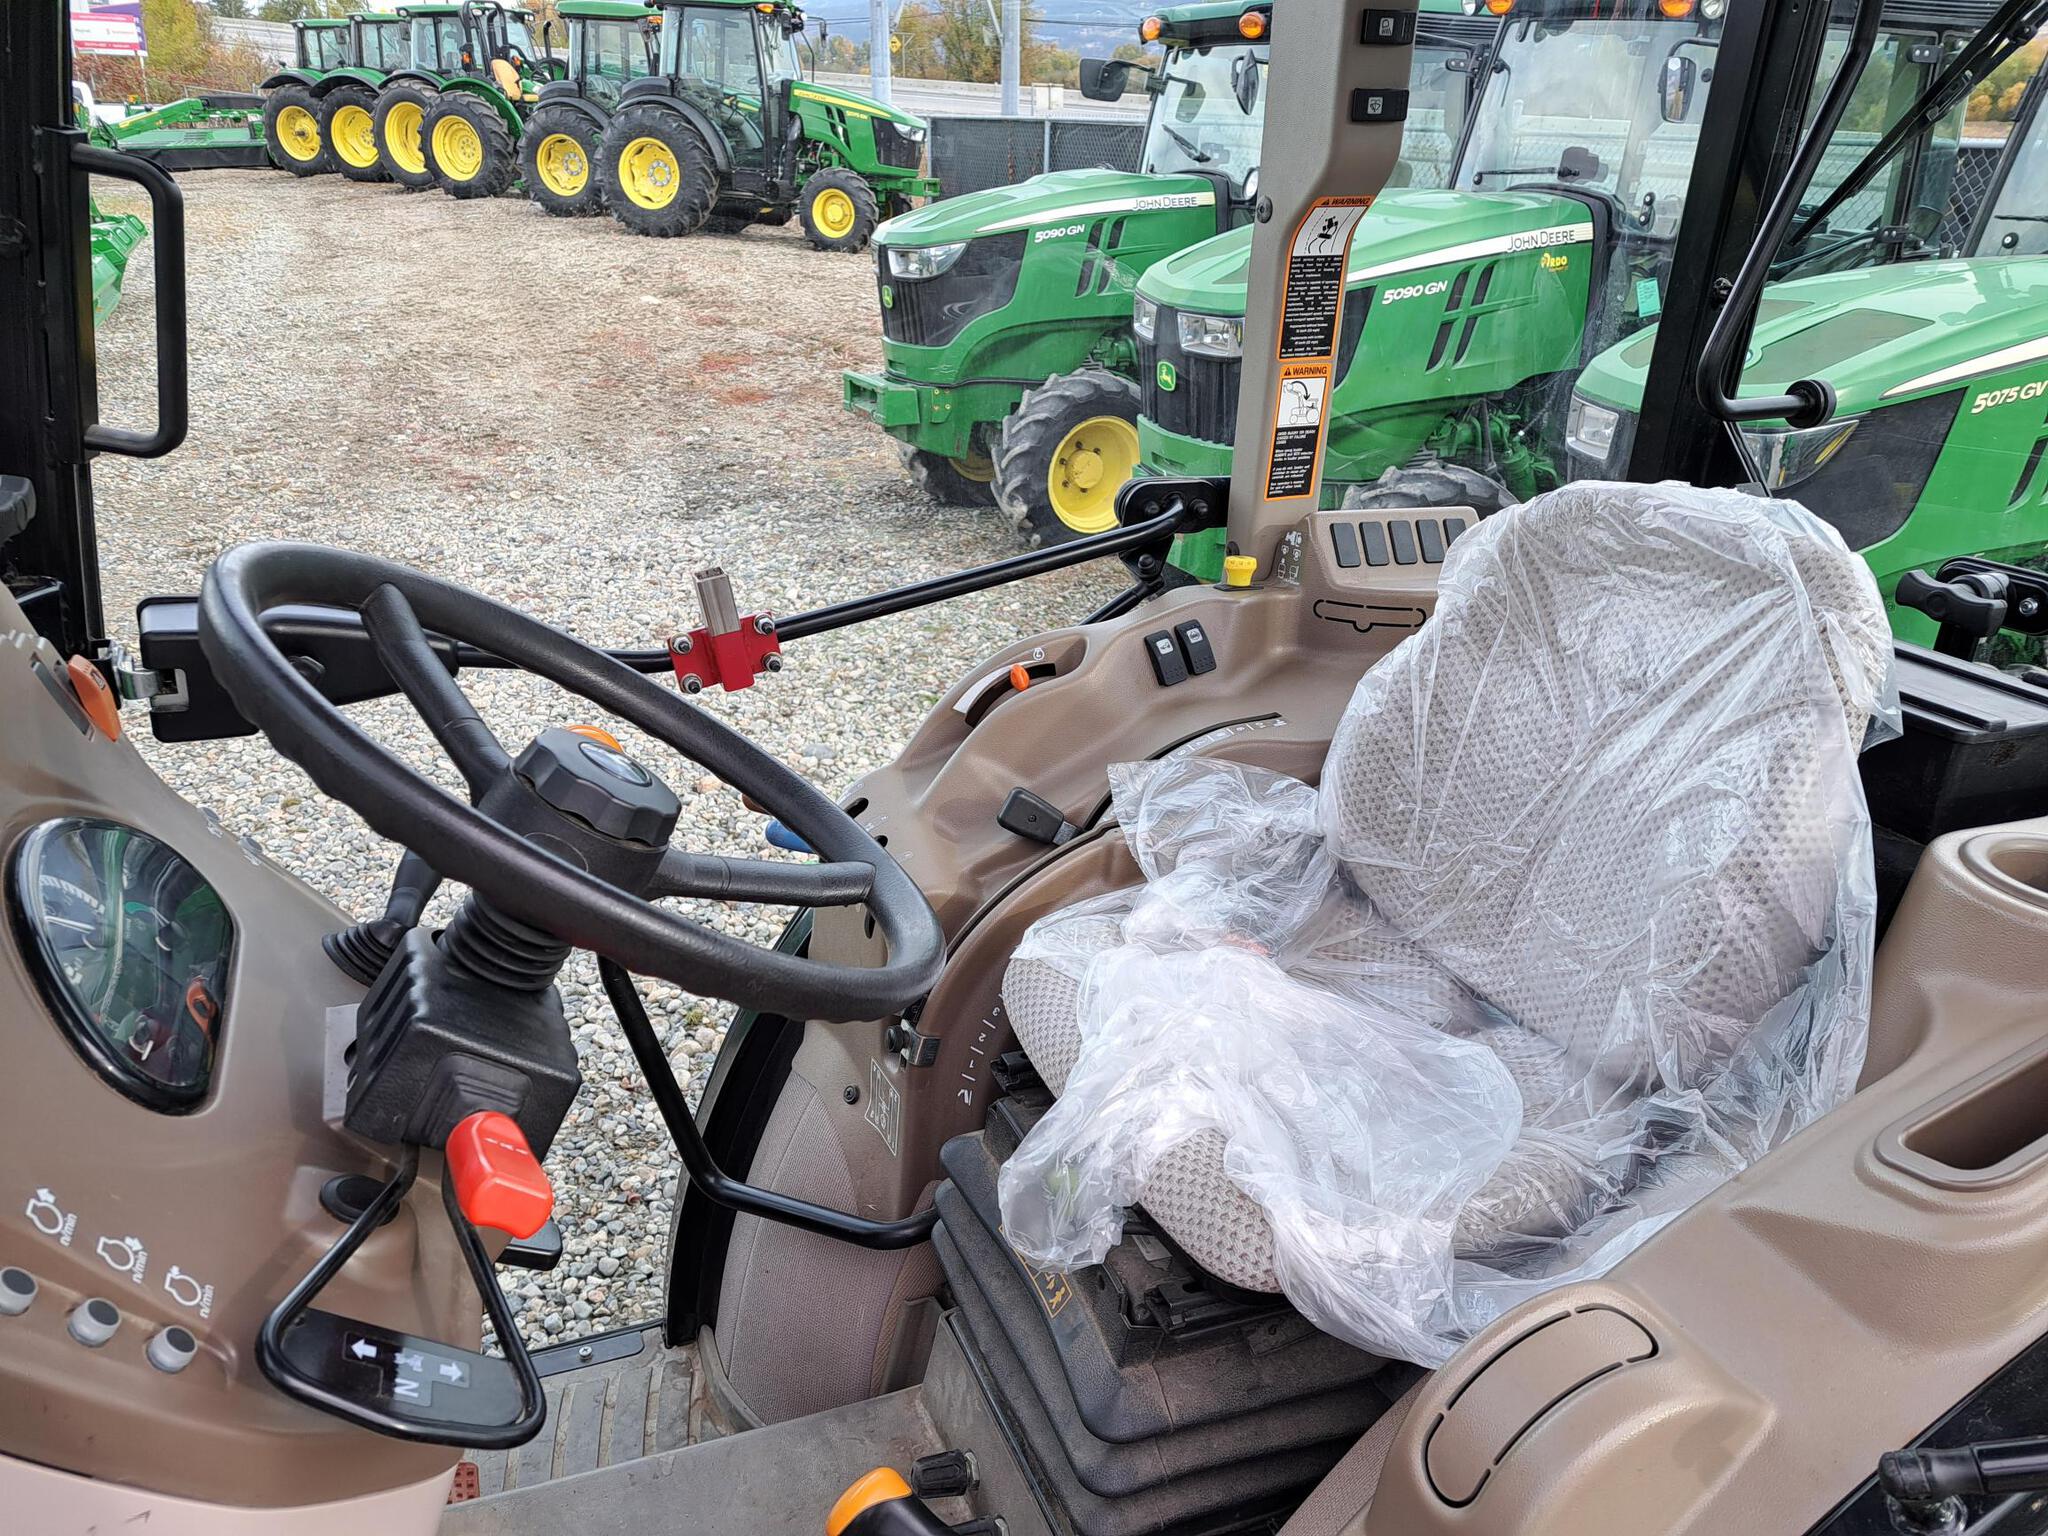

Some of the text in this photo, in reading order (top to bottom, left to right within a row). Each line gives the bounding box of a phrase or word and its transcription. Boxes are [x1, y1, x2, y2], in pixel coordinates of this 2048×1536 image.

[1133, 196, 1198, 210] JOHN DEERE
[1331, 198, 1371, 206] WARNING
[1034, 224, 1085, 243] 5090 GN
[1508, 230, 1576, 251] JOHN DEERE
[1382, 280, 1448, 305] 5090 GN
[1292, 366, 1328, 376] WARNING
[1970, 380, 2048, 414] 5075 GV
[200, 1284, 215, 1319] n/min
